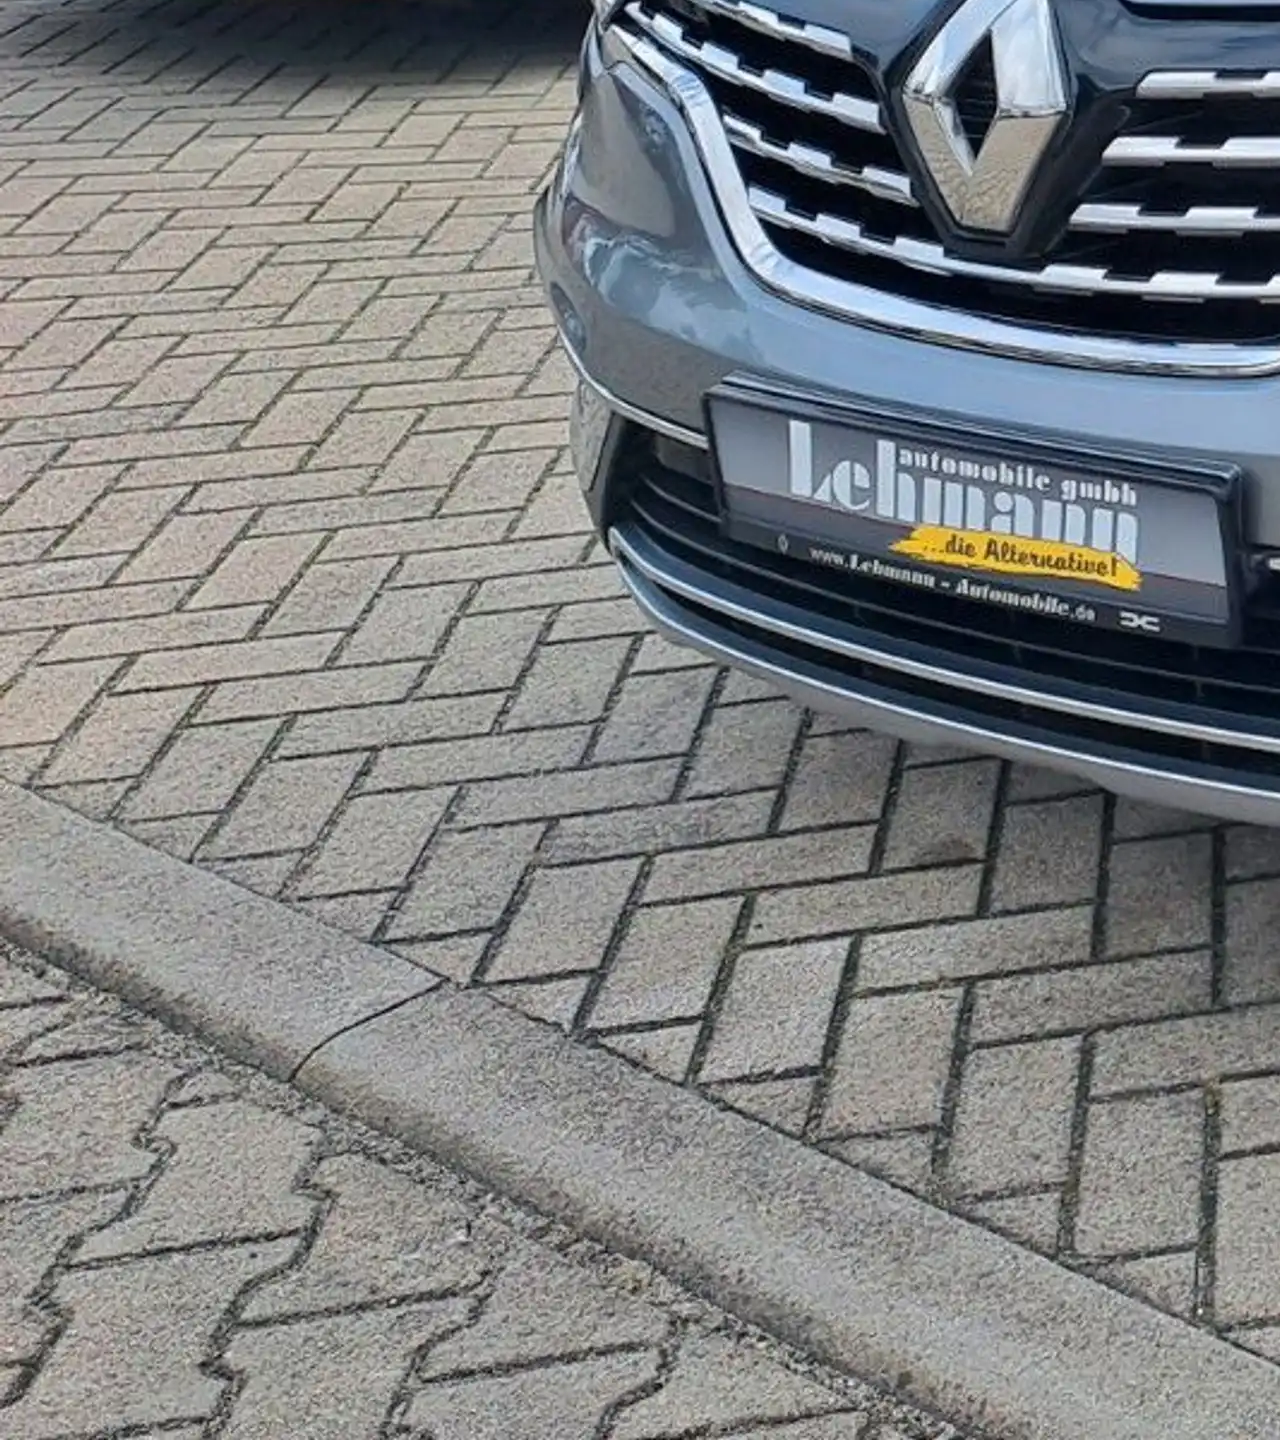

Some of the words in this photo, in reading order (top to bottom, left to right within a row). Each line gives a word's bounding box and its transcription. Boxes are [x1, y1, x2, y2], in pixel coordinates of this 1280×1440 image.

[788, 418, 1140, 563] Lehmann
[899, 447, 1051, 492] automobile
[1060, 479, 1138, 506] gmbh
[983, 537, 1118, 578] Alternative!
